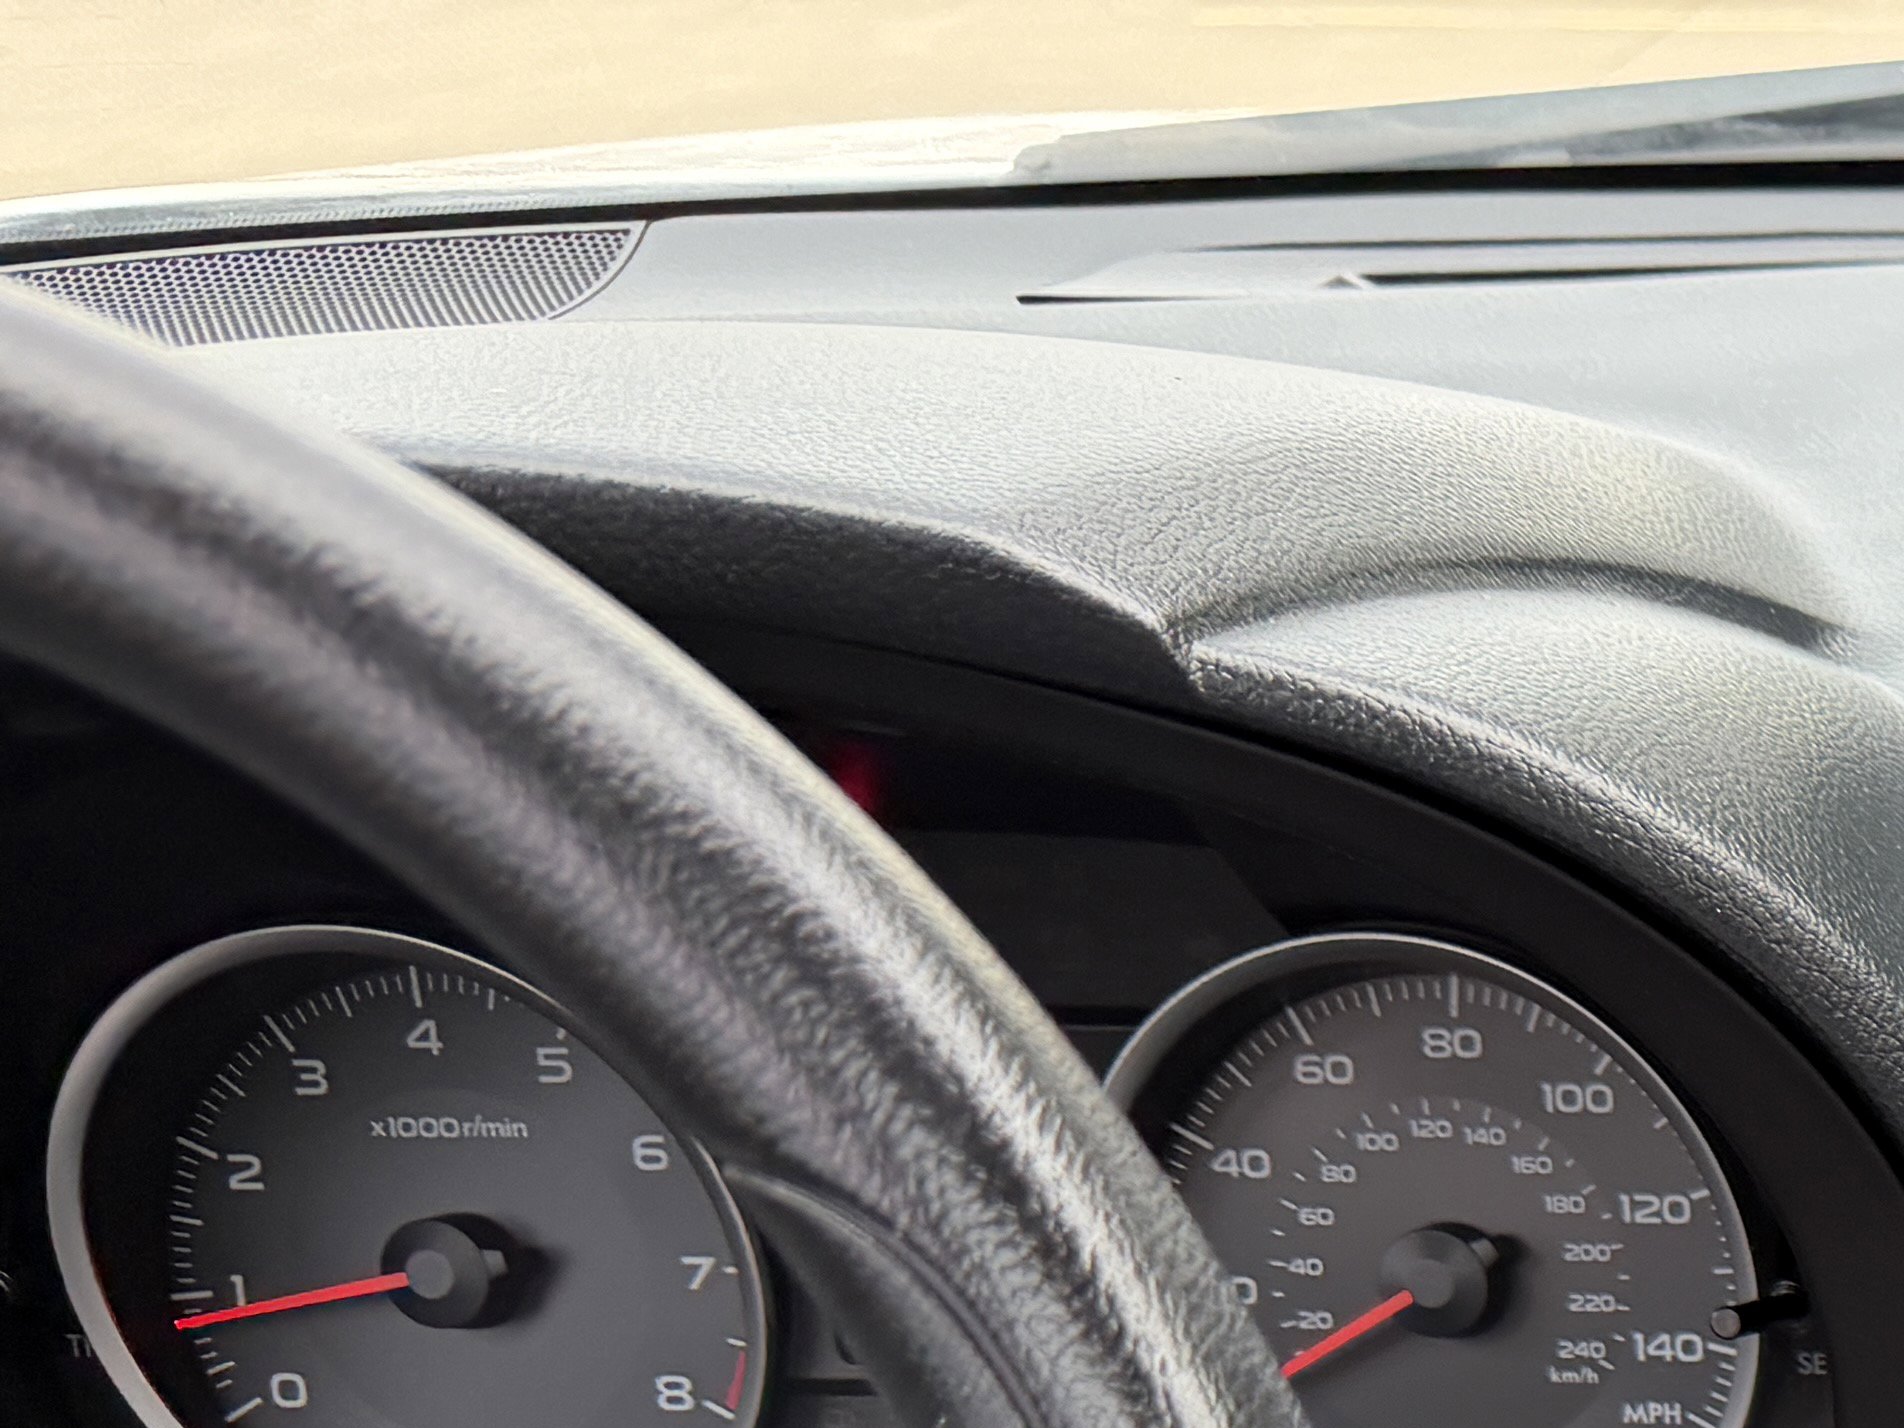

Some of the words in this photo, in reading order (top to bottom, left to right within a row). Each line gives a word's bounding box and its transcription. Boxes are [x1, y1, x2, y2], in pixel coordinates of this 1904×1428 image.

[407, 1019, 444, 1056] 4
[1421, 1028, 1483, 1058] 80
[295, 1058, 328, 1096] 3
[536, 1047, 573, 1084] 5
[1295, 1055, 1354, 1086] 60
[1541, 1083, 1614, 1113] 100
[1355, 1133, 1399, 1151] 100
[1409, 1119, 1453, 1138] 120
[1463, 1126, 1506, 1146] 140
[632, 1134, 669, 1171] 6
[1210, 1149, 1271, 1179] 40
[1511, 1156, 1552, 1174] 160
[228, 1153, 265, 1191] 2
[1320, 1165, 1356, 1183] 80
[1298, 1208, 1334, 1226] 60
[1544, 1196, 1586, 1214] 180
[1619, 1194, 1691, 1224] 120
[1563, 1244, 1611, 1262] 200
[680, 1257, 714, 1290] 7
[1288, 1258, 1324, 1276] 40
[1568, 1294, 1616, 1312] 220
[1297, 1311, 1333, 1330] 20
[1556, 1341, 1606, 1359] 240
[1631, 1332, 1704, 1362] 140
[1548, 1366, 1599, 1384] km/h
[270, 1372, 308, 1409] 0
[656, 1375, 695, 1412] 8
[1623, 1401, 1682, 1425] MPH
